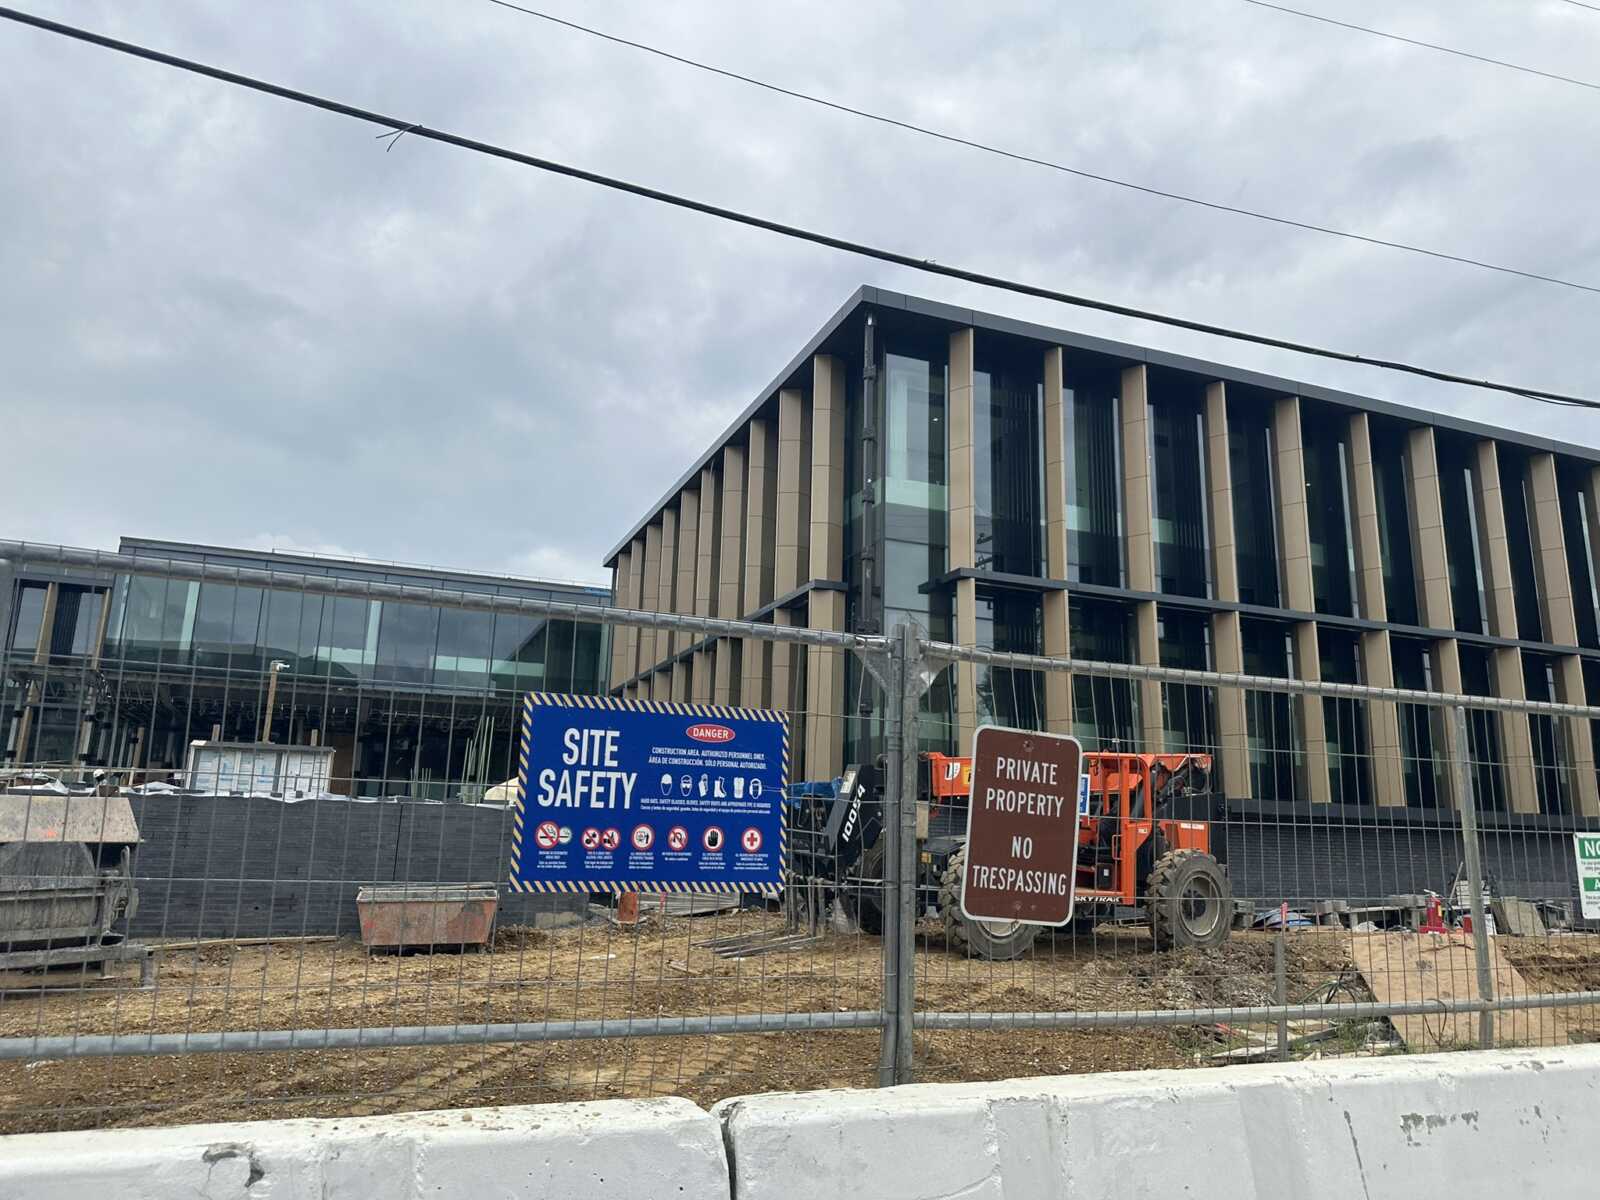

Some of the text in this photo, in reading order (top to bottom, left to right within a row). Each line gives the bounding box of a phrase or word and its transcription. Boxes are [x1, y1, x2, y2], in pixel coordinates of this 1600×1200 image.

[562, 728, 620, 767] SITE
[692, 727, 729, 739] DANGER
[652, 747, 686, 755] CONSTRUCTION
[701, 750, 728, 758] AUTHORIZED
[729, 751, 752, 760] PERSONNEL
[717, 759, 739, 768] PERSONAL
[996, 756, 1058, 785] PRIVATE
[537, 768, 638, 809] SAFETY
[985, 788, 1064, 817] PROPERTY
[842, 784, 866, 842] 10054
[1011, 836, 1033, 859] NO
[972, 865, 1067, 896] TRESPASSING
